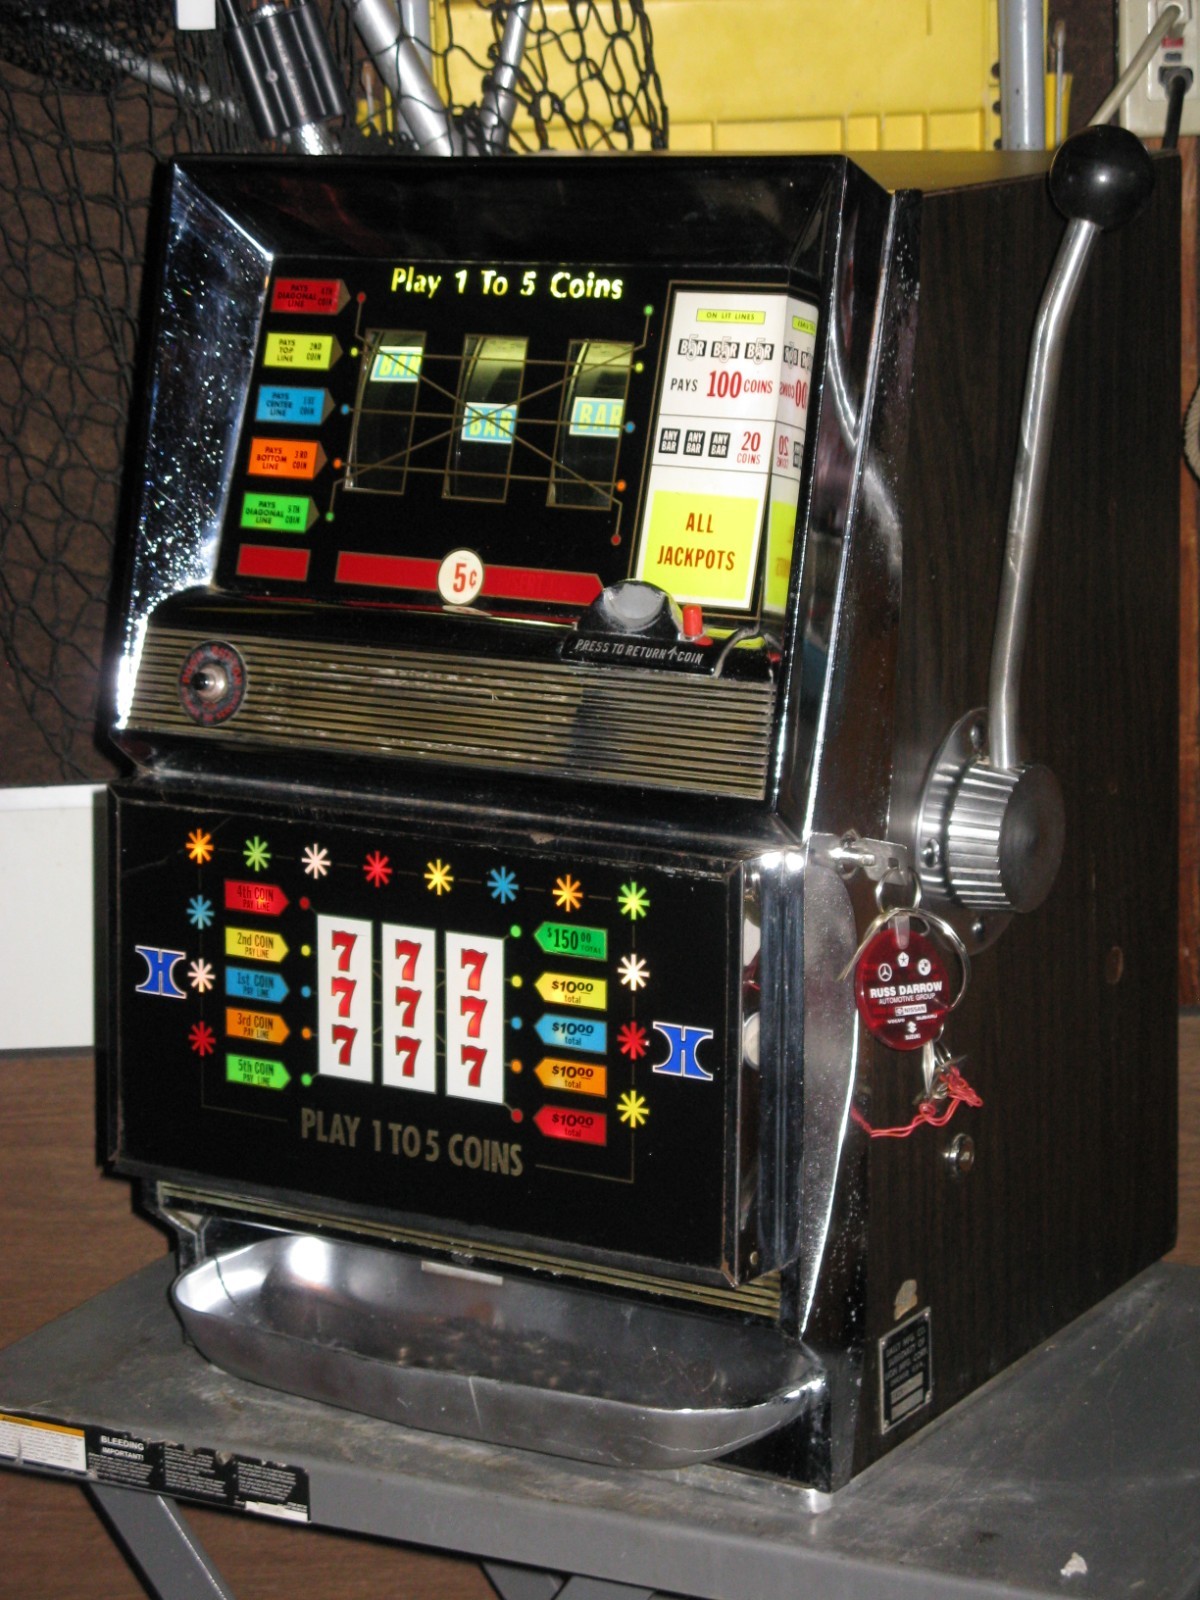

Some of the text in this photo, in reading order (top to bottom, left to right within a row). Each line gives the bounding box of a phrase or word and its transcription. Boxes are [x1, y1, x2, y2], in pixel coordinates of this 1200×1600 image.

[391, 266, 623, 300] Play 1 To 5 Coins
[706, 311, 755, 321] ON LIT LINES
[279, 338, 295, 347] PAYS
[280, 346, 294, 354] TOP
[277, 354, 293, 362] LINE
[670, 370, 774, 399] PAYS 100 COINS
[272, 392, 289, 400] PAYS
[266, 400, 293, 409] CENTER
[270, 408, 286, 416] LINE
[578, 402, 623, 432] BAR
[469, 409, 513, 438] BAR
[663, 429, 678, 441] ANY
[688, 431, 703, 443] ANY
[713, 433, 728, 445] ANY
[661, 440, 677, 452] BAR
[741, 431, 761, 452] 20
[265, 446, 282, 454] PAYS
[686, 442, 702, 454] BAR
[711, 444, 727, 456] BAR
[256, 454, 287, 463] BOTTOM
[295, 450, 308, 459] 3RD
[736, 453, 761, 465] COINS
[262, 462, 279, 470] LINE
[292, 461, 307, 470] COIN
[258, 500, 276, 509] PAYS
[245, 507, 284, 518] DIAGONAL
[256, 516, 272, 524] LINE
[686, 512, 714, 533] ALL
[657, 545, 736, 571] JACKPOTS
[452, 562, 478, 593] 5¢
[574, 638, 704, 664] PRESS TO RETURN COIN
[237, 885, 274, 902] 4th COIN
[243, 899, 270, 911] PAY LINE
[237, 932, 274, 949] 2nd COIN
[245, 946, 269, 958] PAY LINE
[331, 929, 488, 991] 7 7 7
[237, 972, 274, 989] 1st COIN
[870, 981, 943, 998] RUSS DARROW
[564, 994, 581, 1004] total
[879, 993, 936, 1005] AUTOMOTIVE GROUP
[331, 976, 488, 1038] 7 7 7
[904, 1005, 925, 1013] NISSAN
[237, 1012, 274, 1030] 3rd COIN
[243, 1027, 269, 1039] PAY LINE
[565, 1036, 581, 1046] total
[331, 1023, 488, 1088] 7 7 7
[238, 1059, 274, 1076] 5th COIN
[243, 1073, 270, 1085] PAY LINE
[565, 1079, 581, 1089] total
[565, 1128, 581, 1138] total
[301, 1107, 524, 1177] PLAY 1 TO 5 COINS
[100, 1435, 144, 1451] BLEEDING
[101, 1446, 144, 1460] IMPORTANT!
